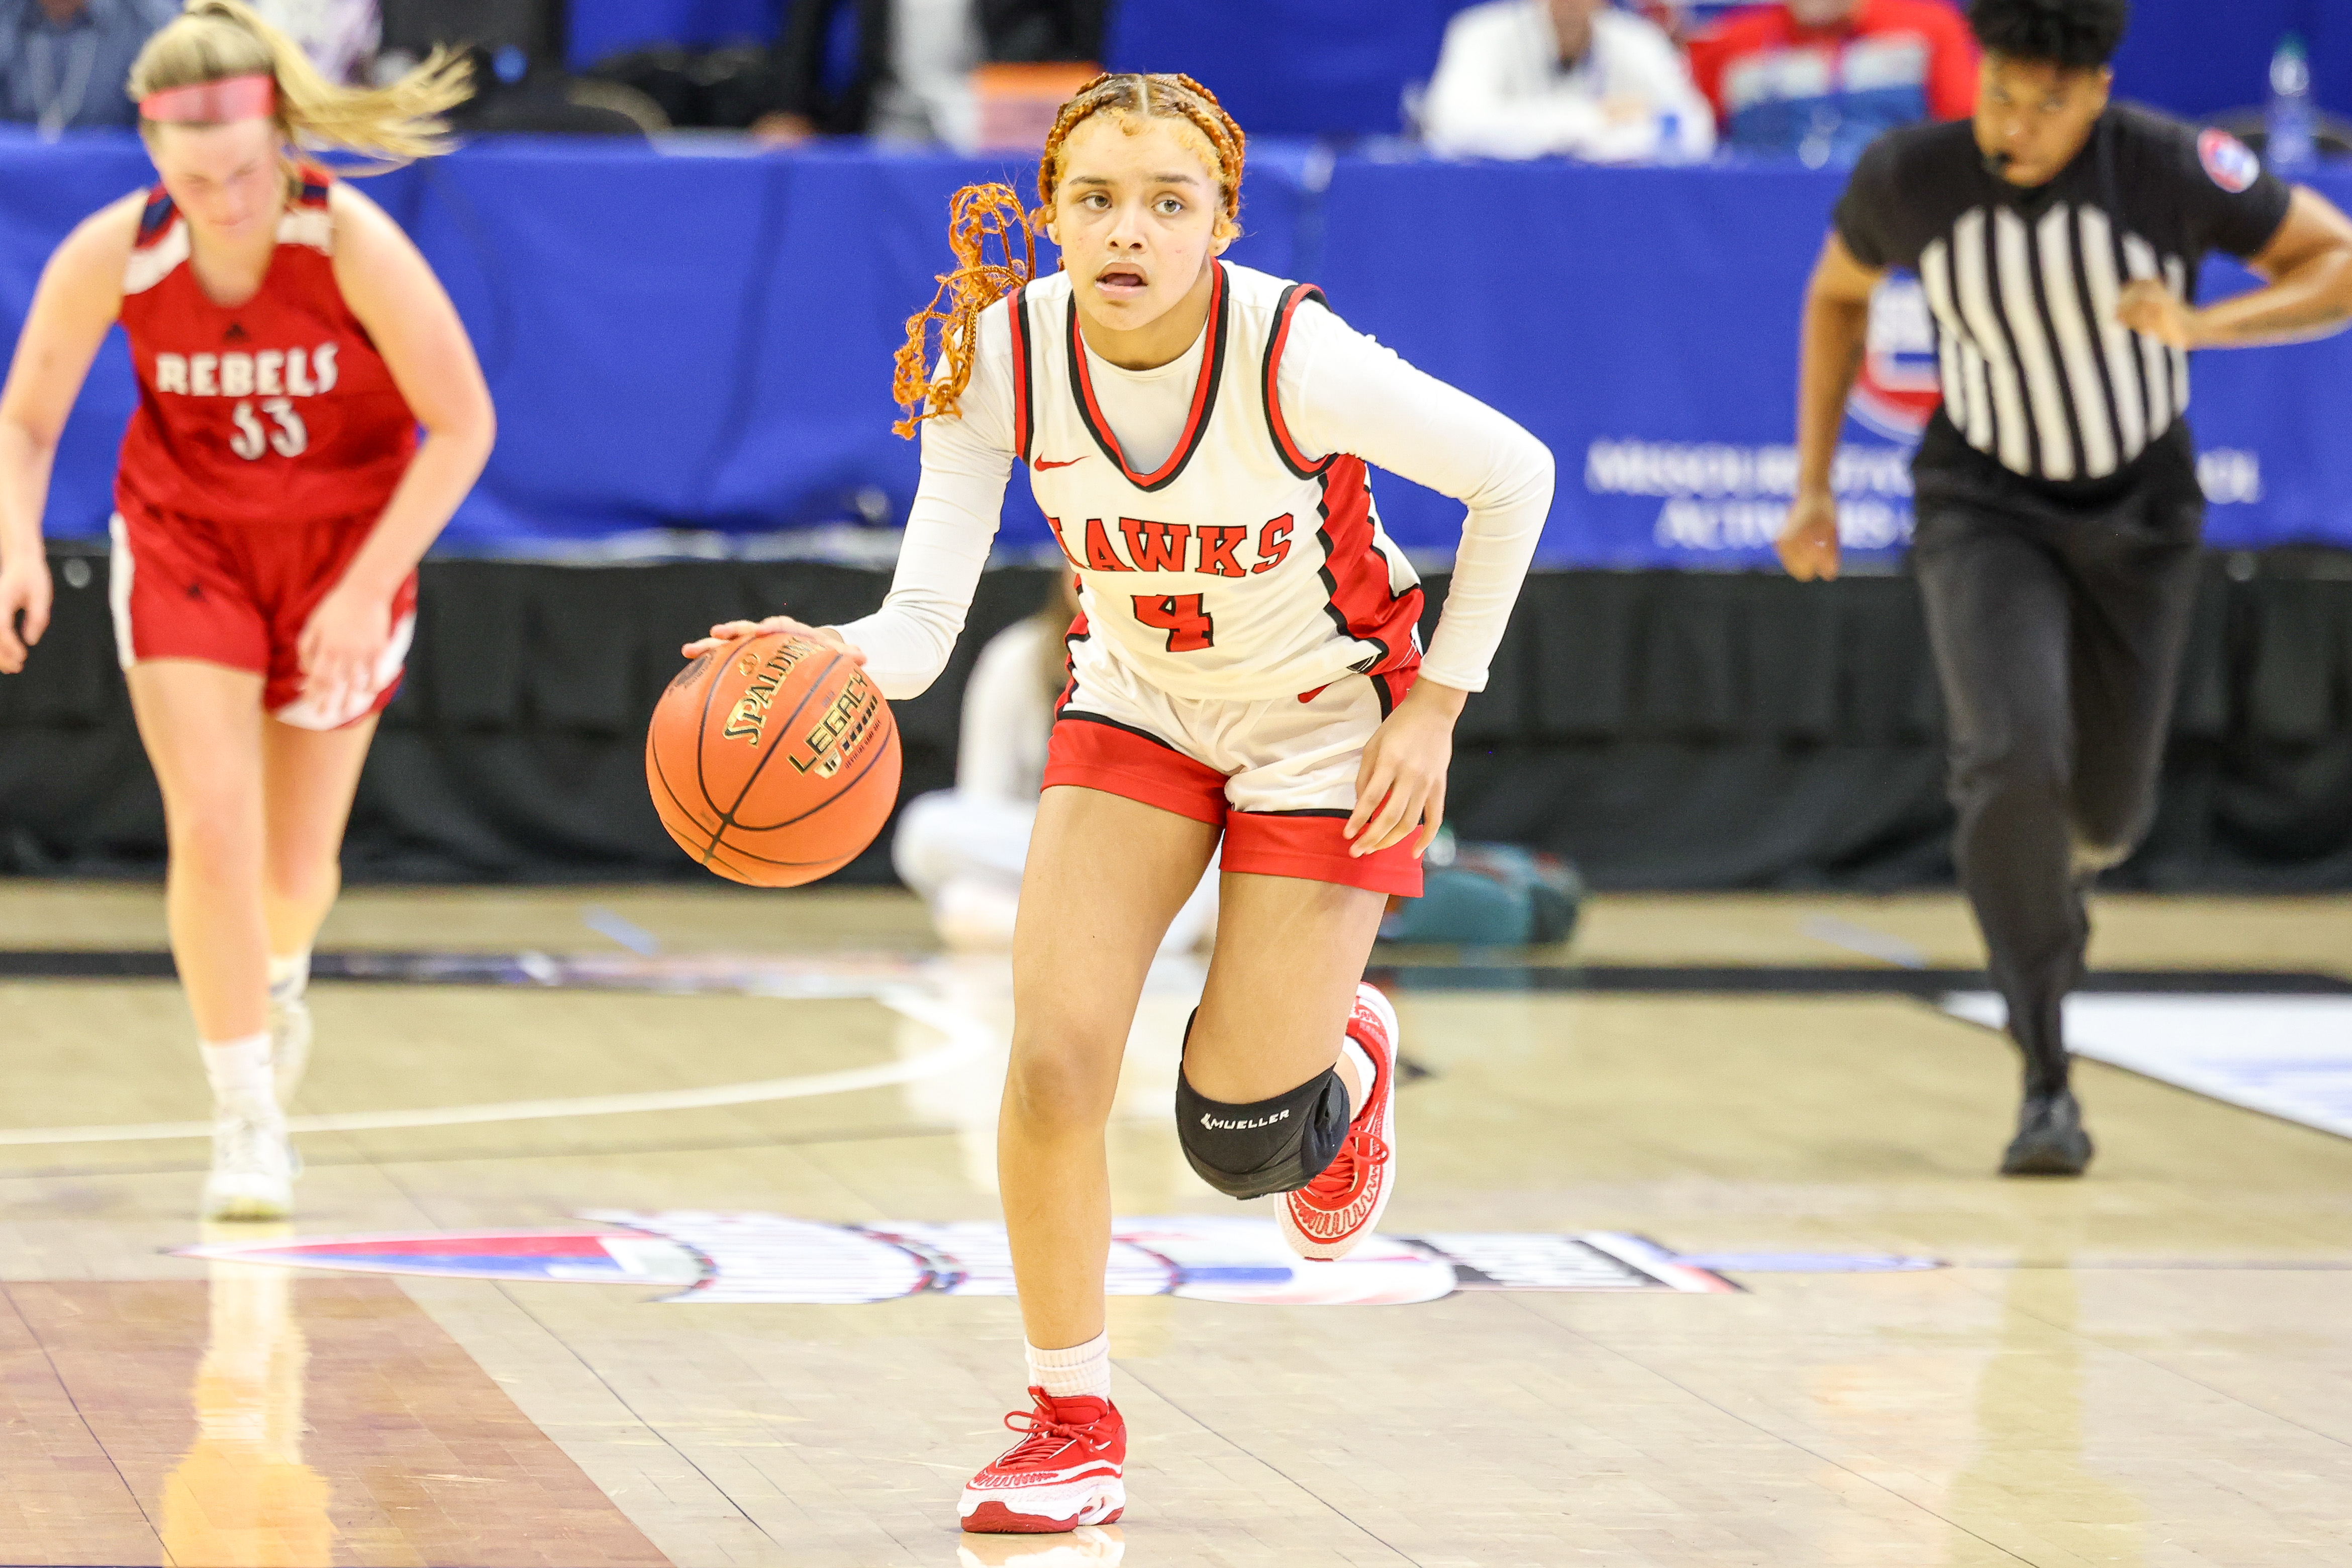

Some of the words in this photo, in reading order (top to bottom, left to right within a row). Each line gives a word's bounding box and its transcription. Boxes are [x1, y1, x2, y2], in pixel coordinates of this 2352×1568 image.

[155, 341, 338, 397] REBELS
[1046, 512, 1294, 577] AWKS
[1130, 593, 1215, 652] 4
[723, 636, 827, 748] SPALDIN
[786, 667, 868, 777] LEGACY
[1211, 1109, 1290, 1130] MUELLER
